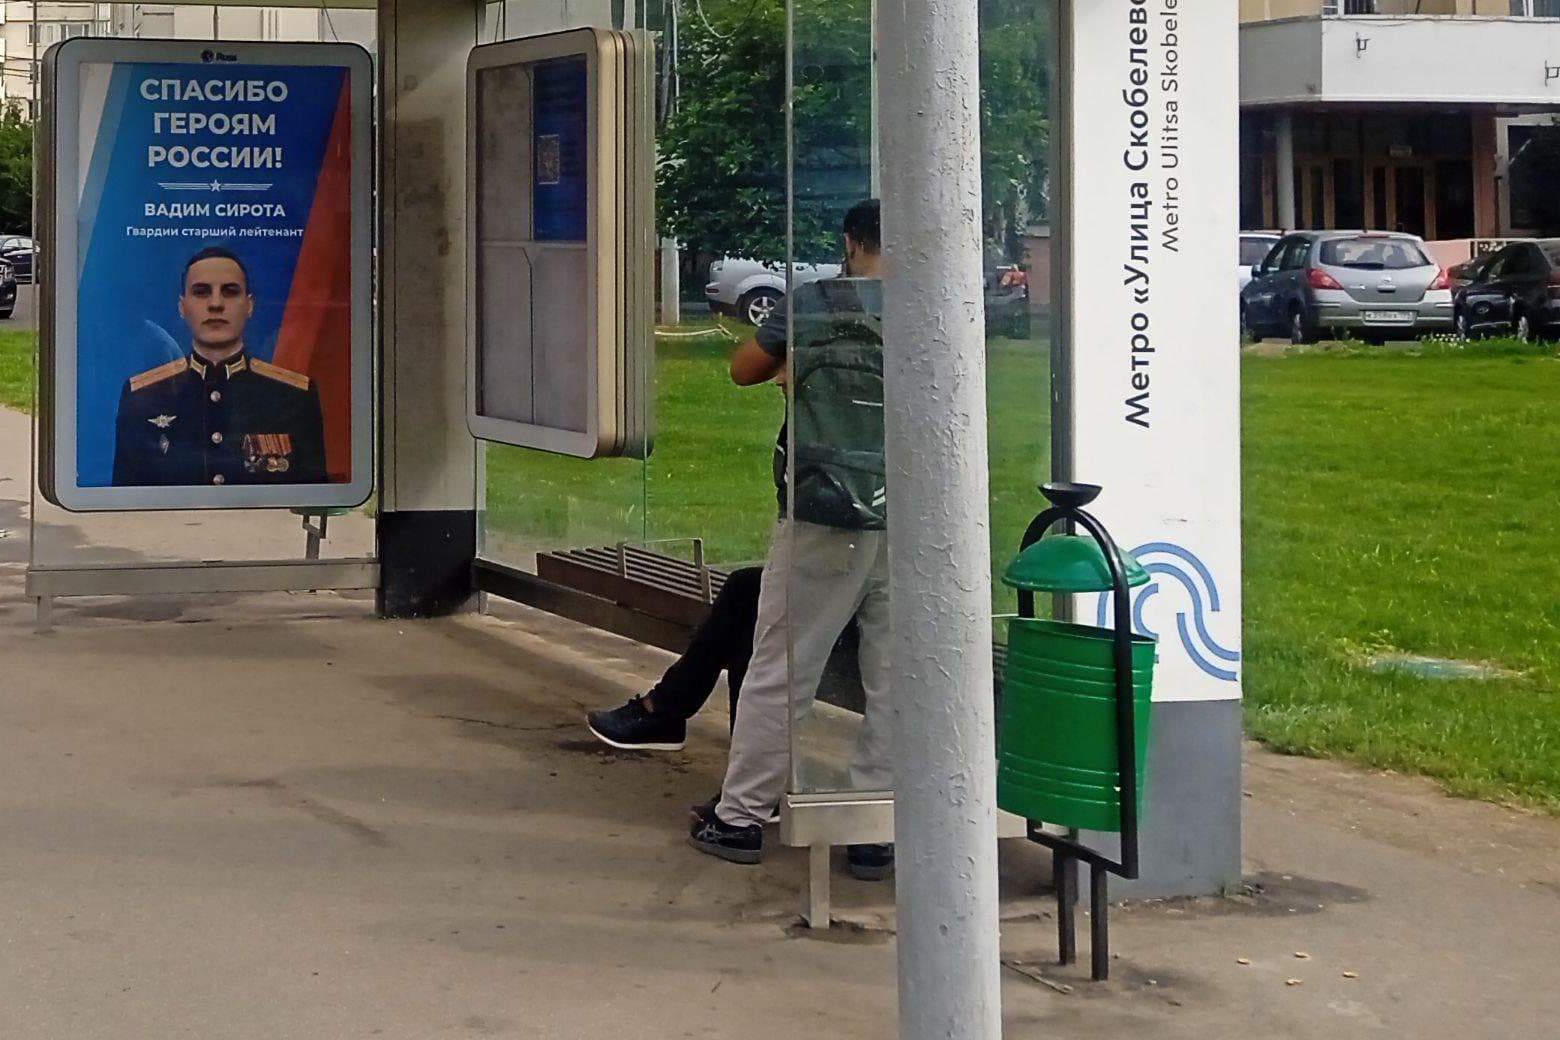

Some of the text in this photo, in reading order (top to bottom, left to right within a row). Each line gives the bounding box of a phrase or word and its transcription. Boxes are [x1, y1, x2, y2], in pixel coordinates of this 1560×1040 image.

[140, 78, 288, 102] СПАСИБО
[153, 112, 276, 135] ГЕРОЯМ
[1161, 100, 1179, 169] Ulitsa
[148, 146, 283, 168] РОССИИ!
[145, 203, 286, 219] ВАДИМ СИРОТА
[1162, 177, 1179, 252] Metro
[126, 226, 304, 238] Гвардии старший лейтенант
[1124, 182, 1152, 304] «Улица
[1125, 312, 1155, 428] Метро
